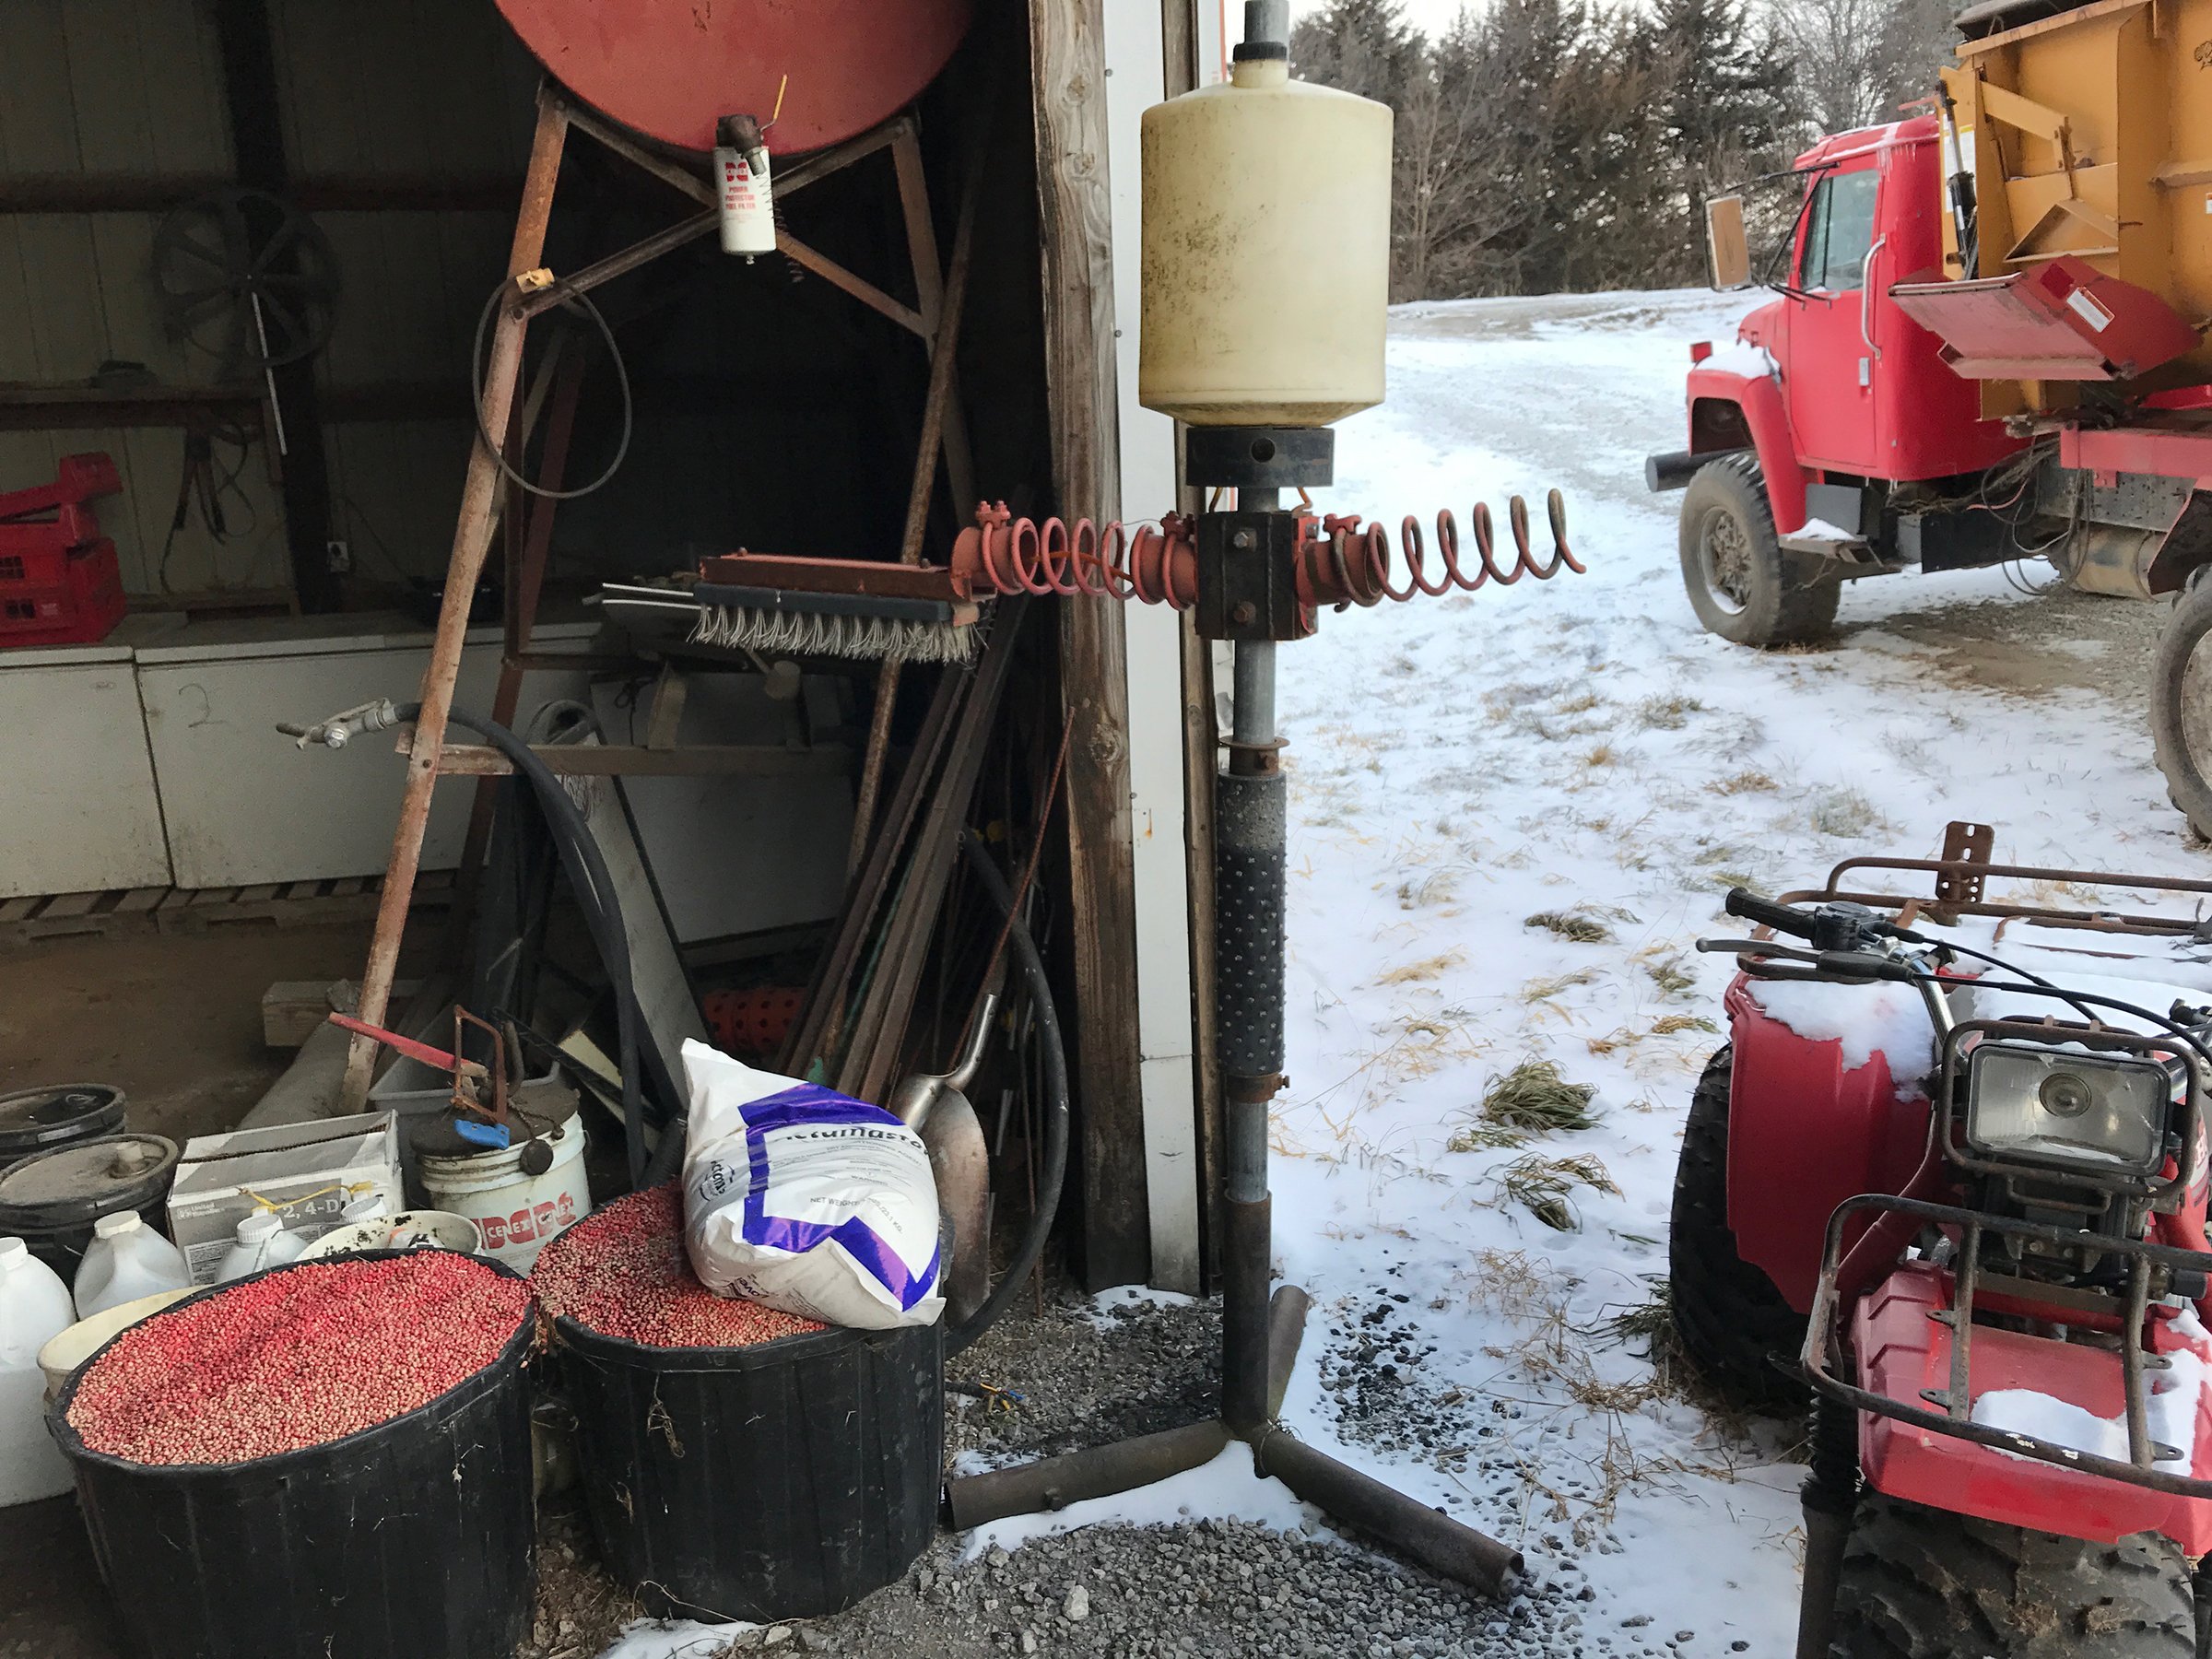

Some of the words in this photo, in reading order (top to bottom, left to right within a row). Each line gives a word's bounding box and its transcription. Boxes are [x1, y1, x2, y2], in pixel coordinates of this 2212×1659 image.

[283, 1206, 301, 1219] 2,
[304, 1198, 339, 1216] 4-D
[486, 1218, 533, 1239] CENEX
